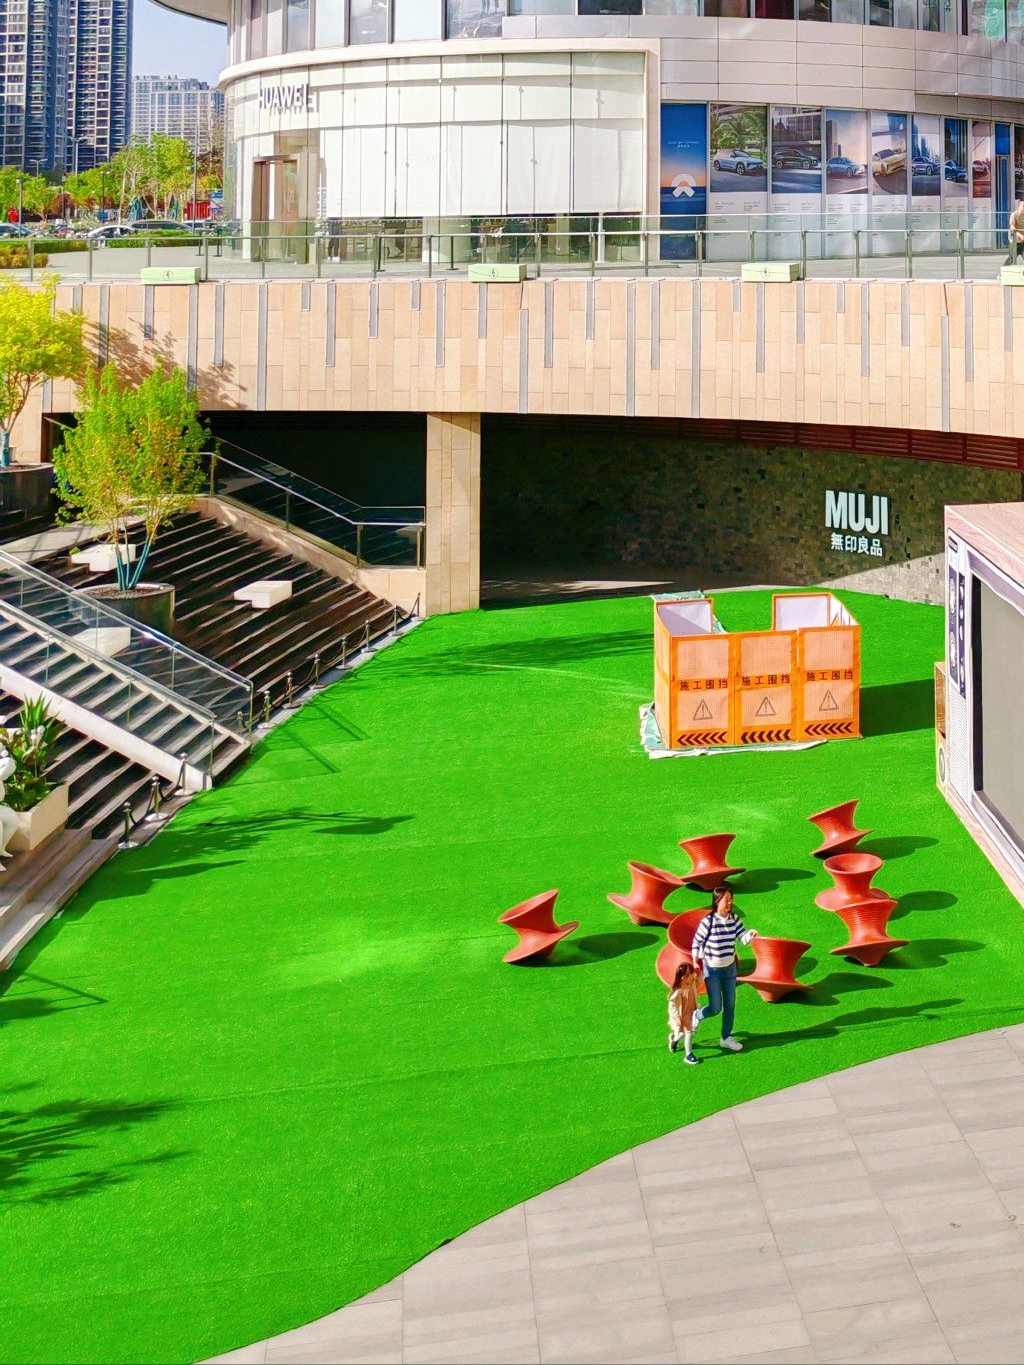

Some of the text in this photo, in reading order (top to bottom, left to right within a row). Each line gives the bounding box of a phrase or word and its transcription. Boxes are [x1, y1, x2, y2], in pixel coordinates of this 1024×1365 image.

[257, 83, 309, 111] HUAWEI
[825, 489, 889, 536] MUJI
[830, 531, 883, 557] 無印良品
[679, 678, 728, 692] 施工围挡
[741, 673, 791, 687] 施工围挡
[806, 669, 853, 682] 施工围挡
